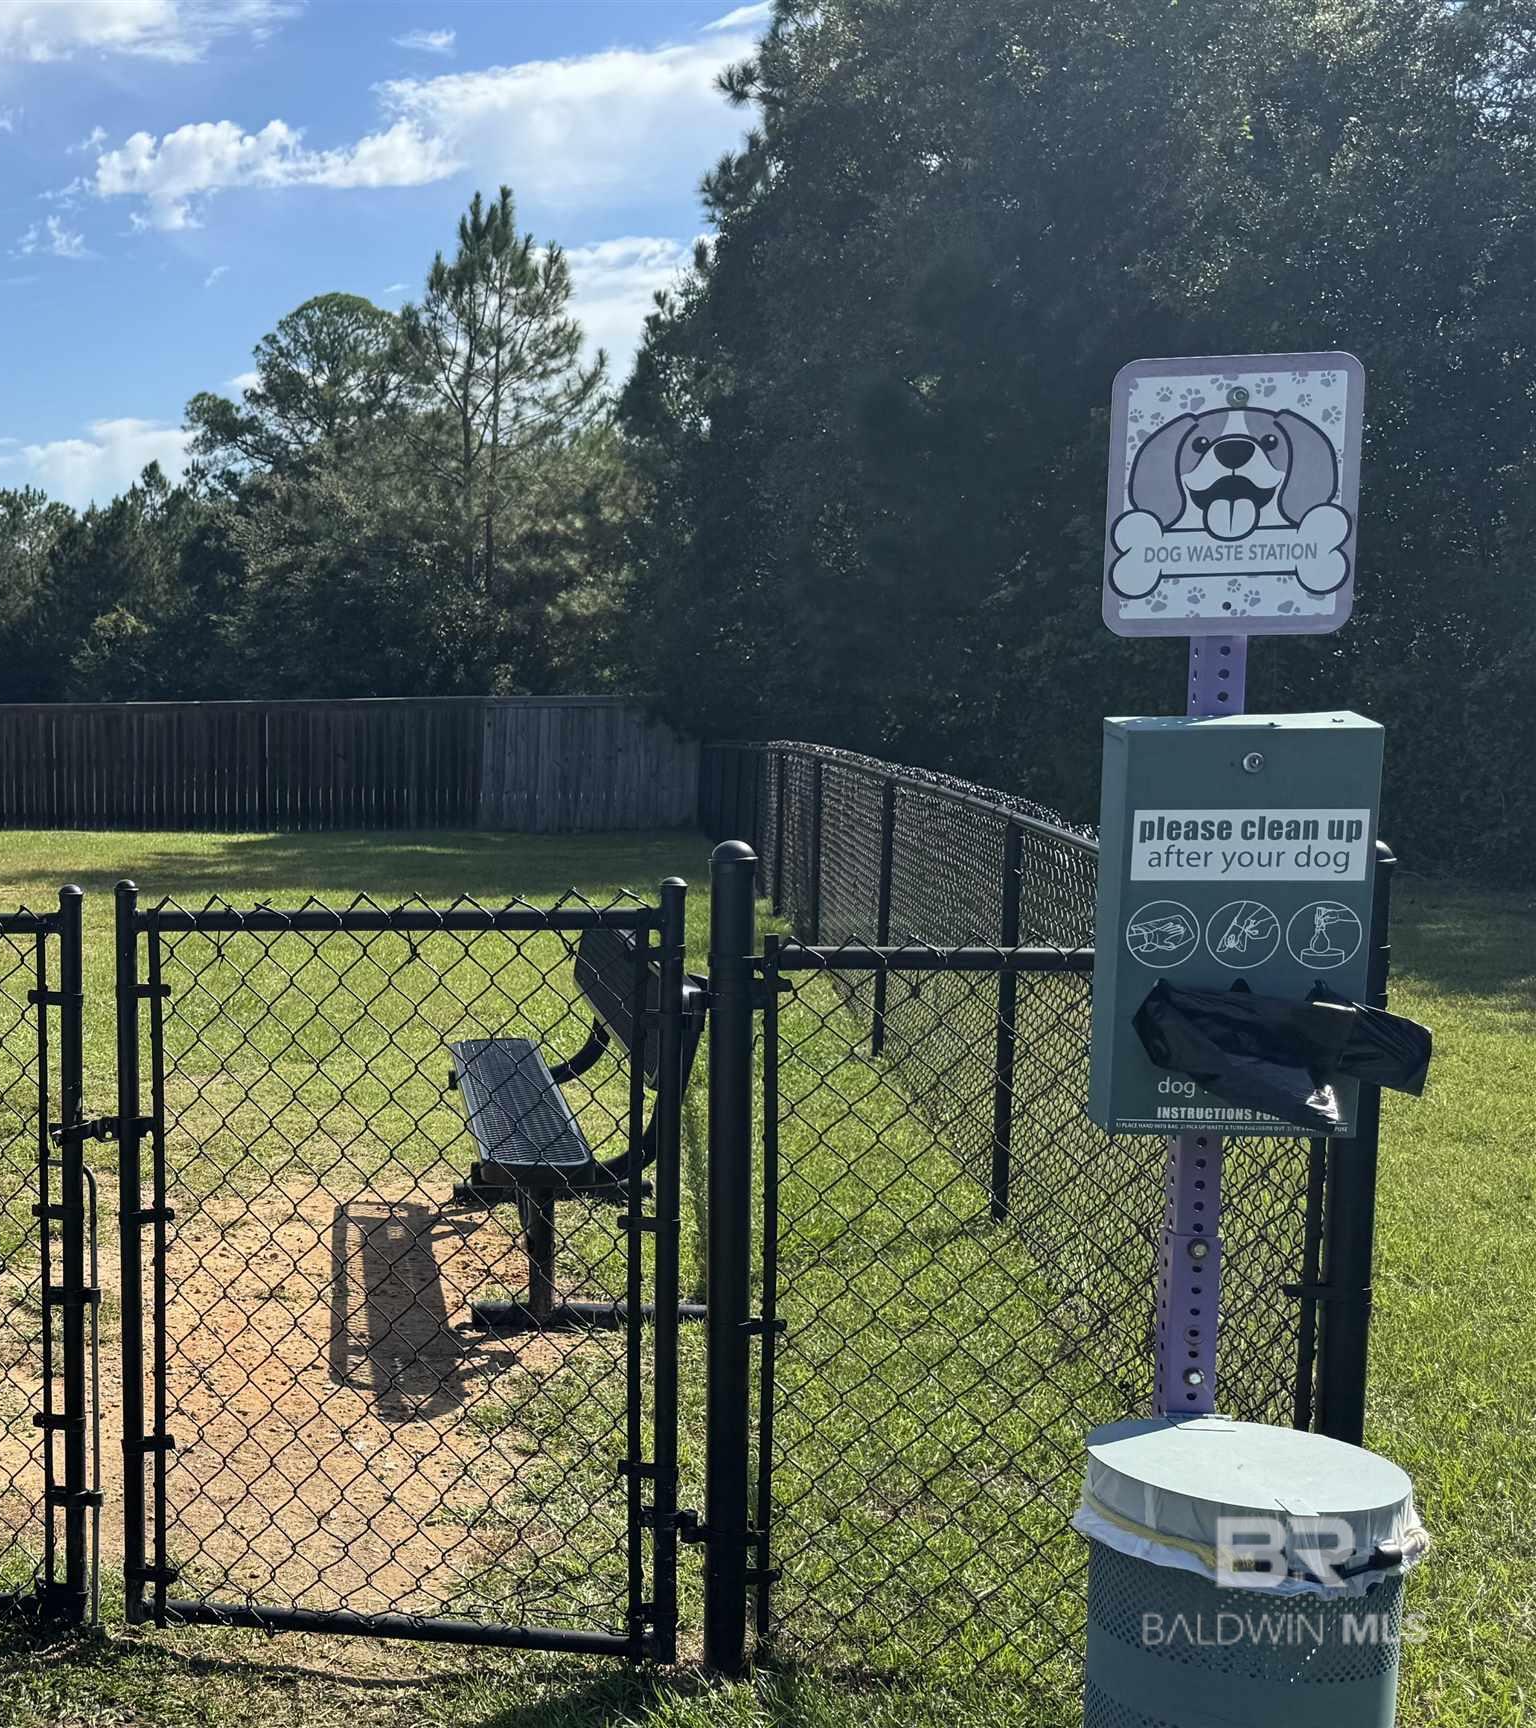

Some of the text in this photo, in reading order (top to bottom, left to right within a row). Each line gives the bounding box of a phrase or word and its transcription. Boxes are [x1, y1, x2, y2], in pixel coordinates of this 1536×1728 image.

[1144, 543, 1318, 563] DOG WASTE STATION
[1139, 816, 1363, 843] please clean up
[1147, 844, 1351, 873] after your dog
[1157, 1076, 1196, 1098] dog
[1157, 1106, 1252, 1121] INSTRUCTIONS
